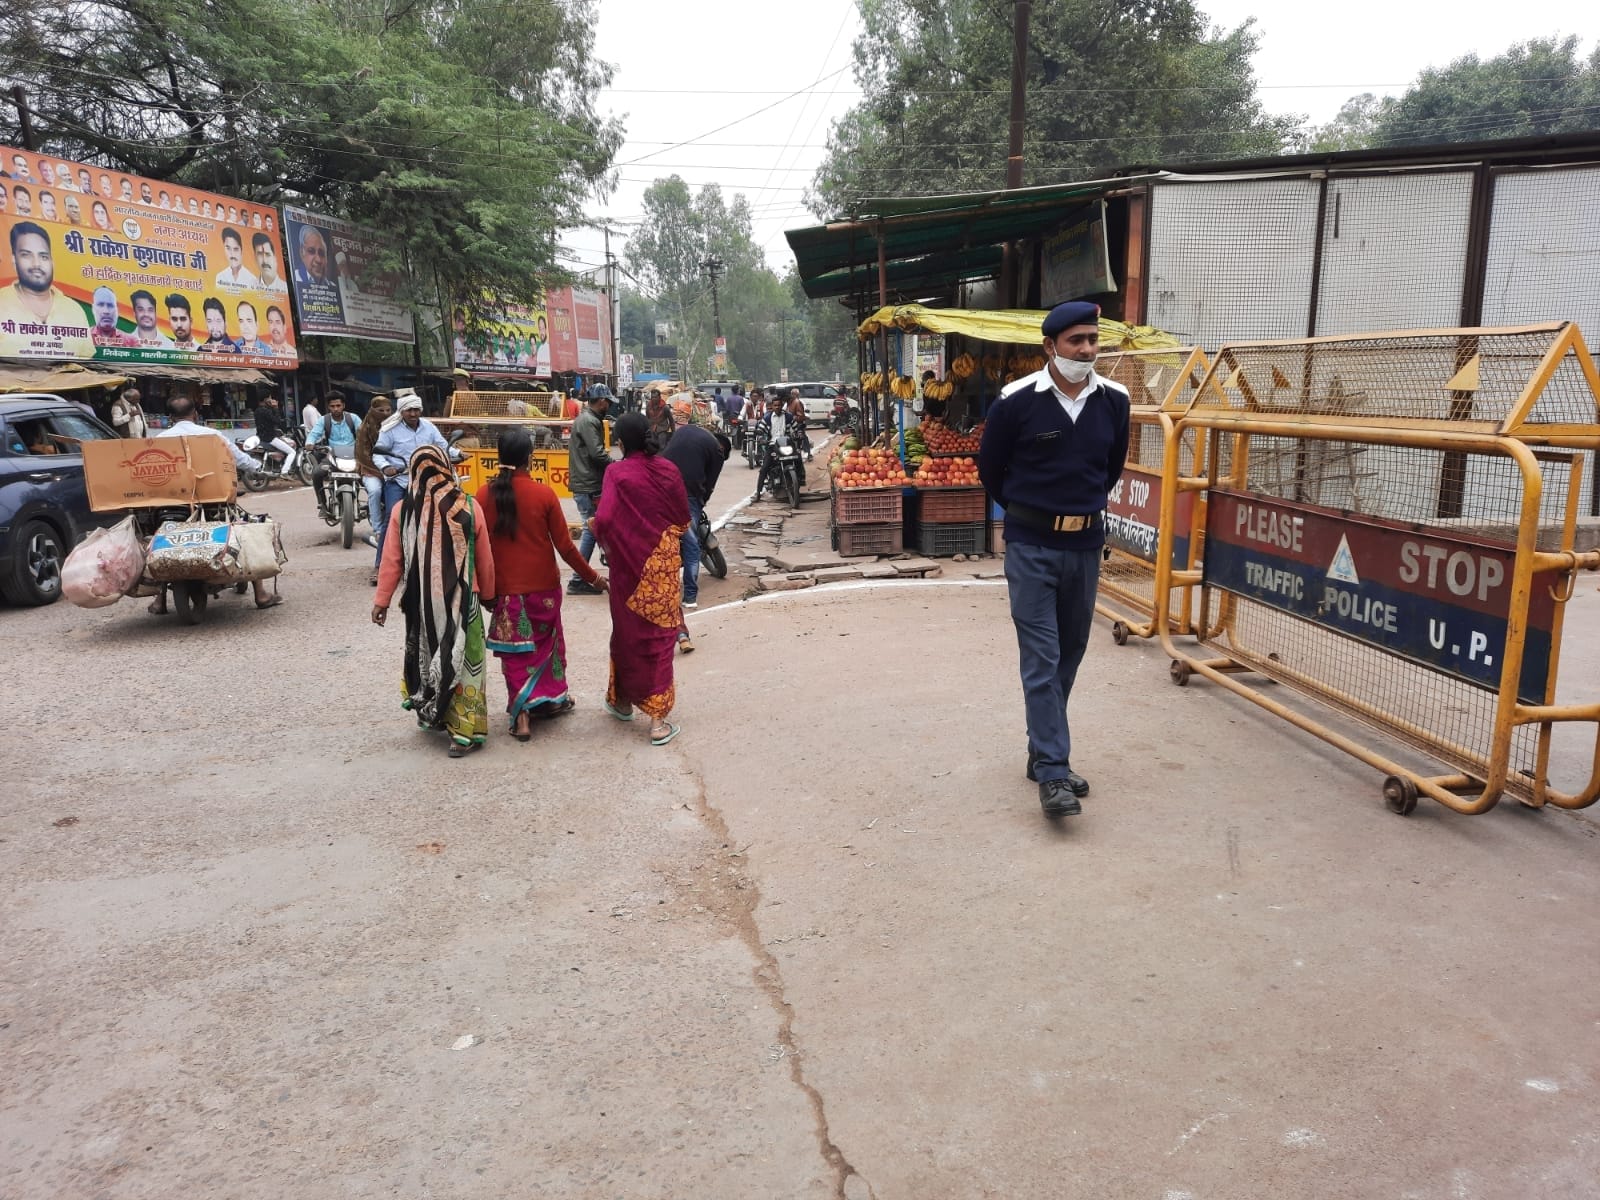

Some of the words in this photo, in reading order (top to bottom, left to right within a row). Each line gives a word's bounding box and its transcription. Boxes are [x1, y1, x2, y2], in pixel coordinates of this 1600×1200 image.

[65, 230, 84, 254] श्री
[88, 235, 129, 260] राकेश
[132, 244, 186, 268] कुशवाहा
[189, 250, 207, 271] जी
[1, 320, 15, 334] श्री
[19, 322, 48, 336] राकेश
[51, 325, 88, 341] कुशवाहा
[133, 463, 177, 476] JAYANTI
[1129, 478, 1150, 508] STOP
[1236, 504, 1304, 553] PLEASE
[1399, 541, 1505, 602] STOP
[1245, 561, 1304, 601] TRAFFIC
[1323, 586, 1398, 633] POLICE
